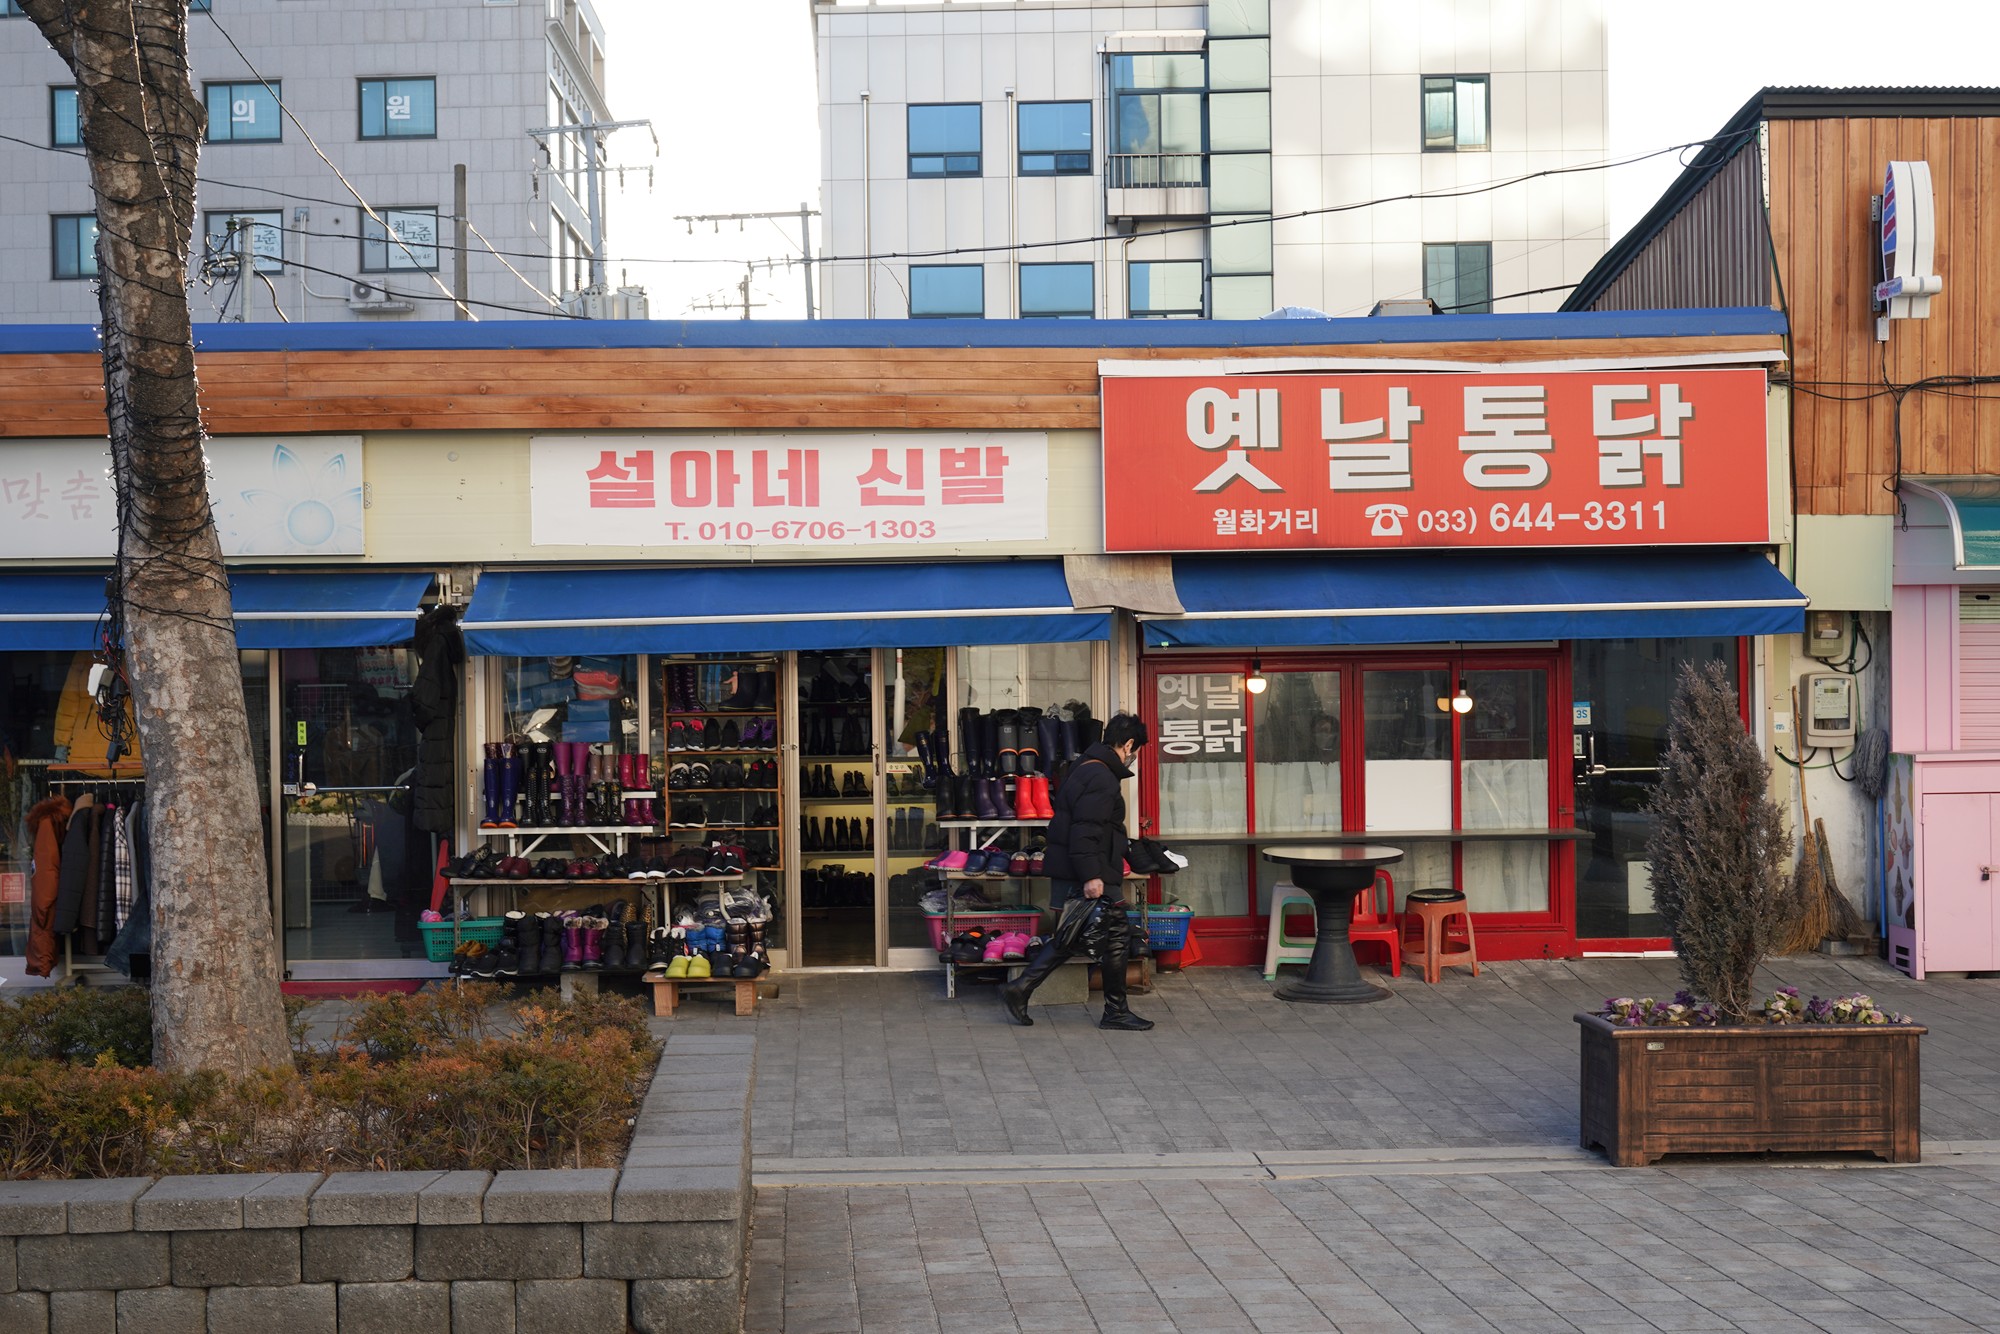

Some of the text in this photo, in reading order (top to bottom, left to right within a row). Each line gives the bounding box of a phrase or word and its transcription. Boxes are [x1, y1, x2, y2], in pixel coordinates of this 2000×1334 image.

[232, 95, 411, 124] 의 원
[586, 445, 1010, 509] 설아네 신발
[698, 519, 937, 541] 010-6706-1303
[1212, 500, 1668, 536] 월화거리 033) 644-3311
[1158, 674, 1246, 711] 옛날
[1158, 717, 1247, 755] 통닭
